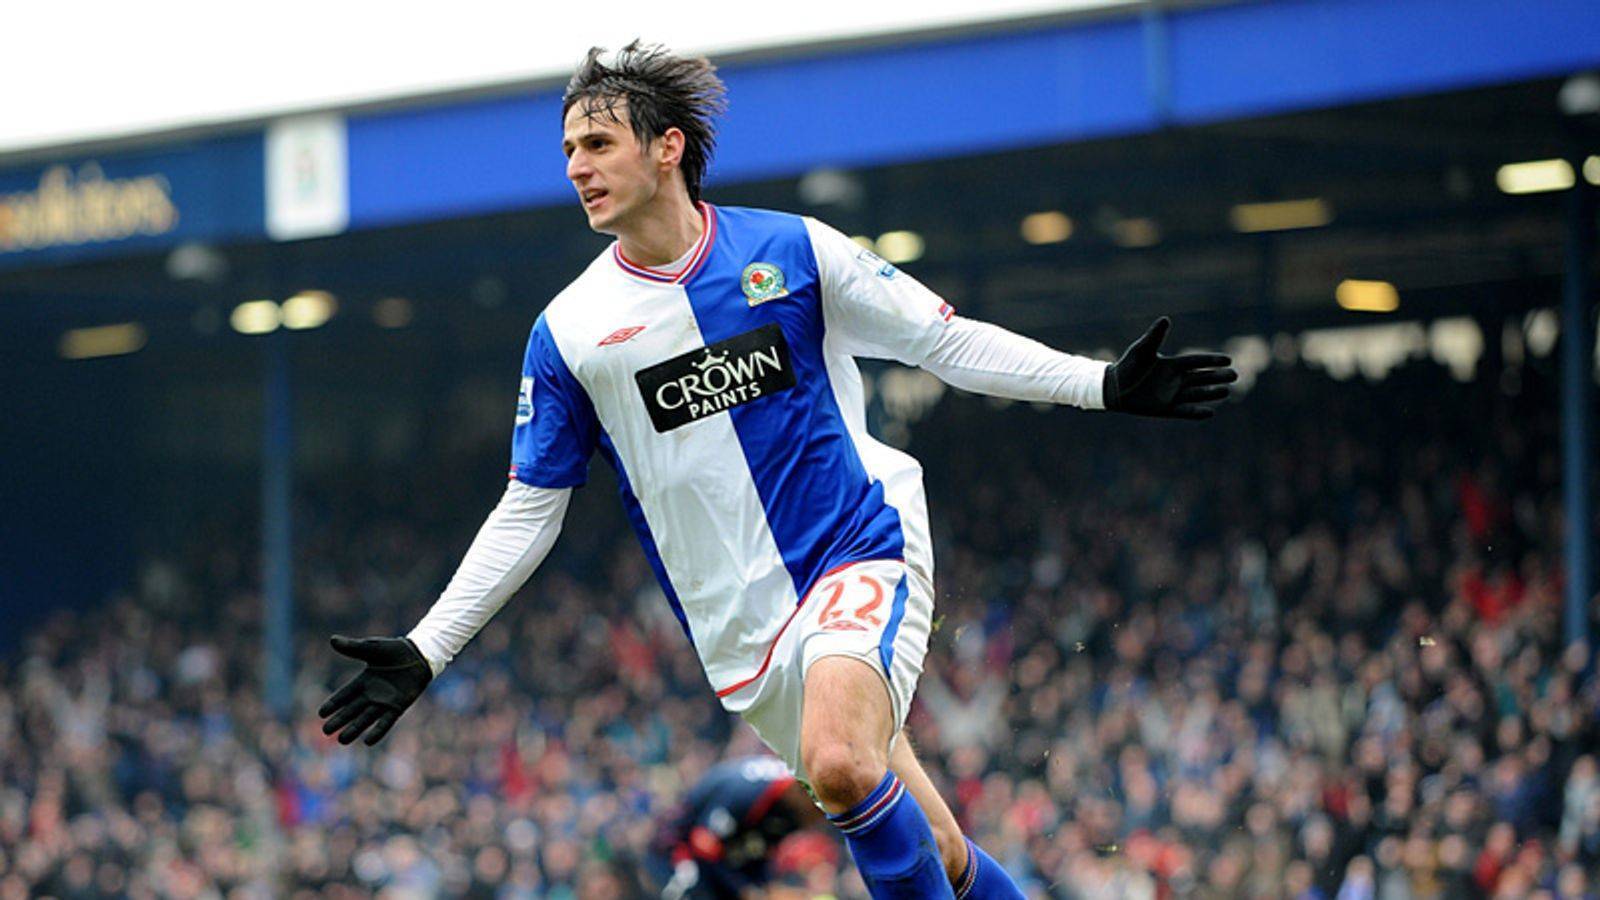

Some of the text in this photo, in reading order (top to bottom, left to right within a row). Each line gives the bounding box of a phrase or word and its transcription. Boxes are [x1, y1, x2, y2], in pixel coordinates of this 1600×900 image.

[656, 346, 782, 409] CROWN
[688, 382, 762, 418] PAINTS
[818, 575, 884, 626] 22
